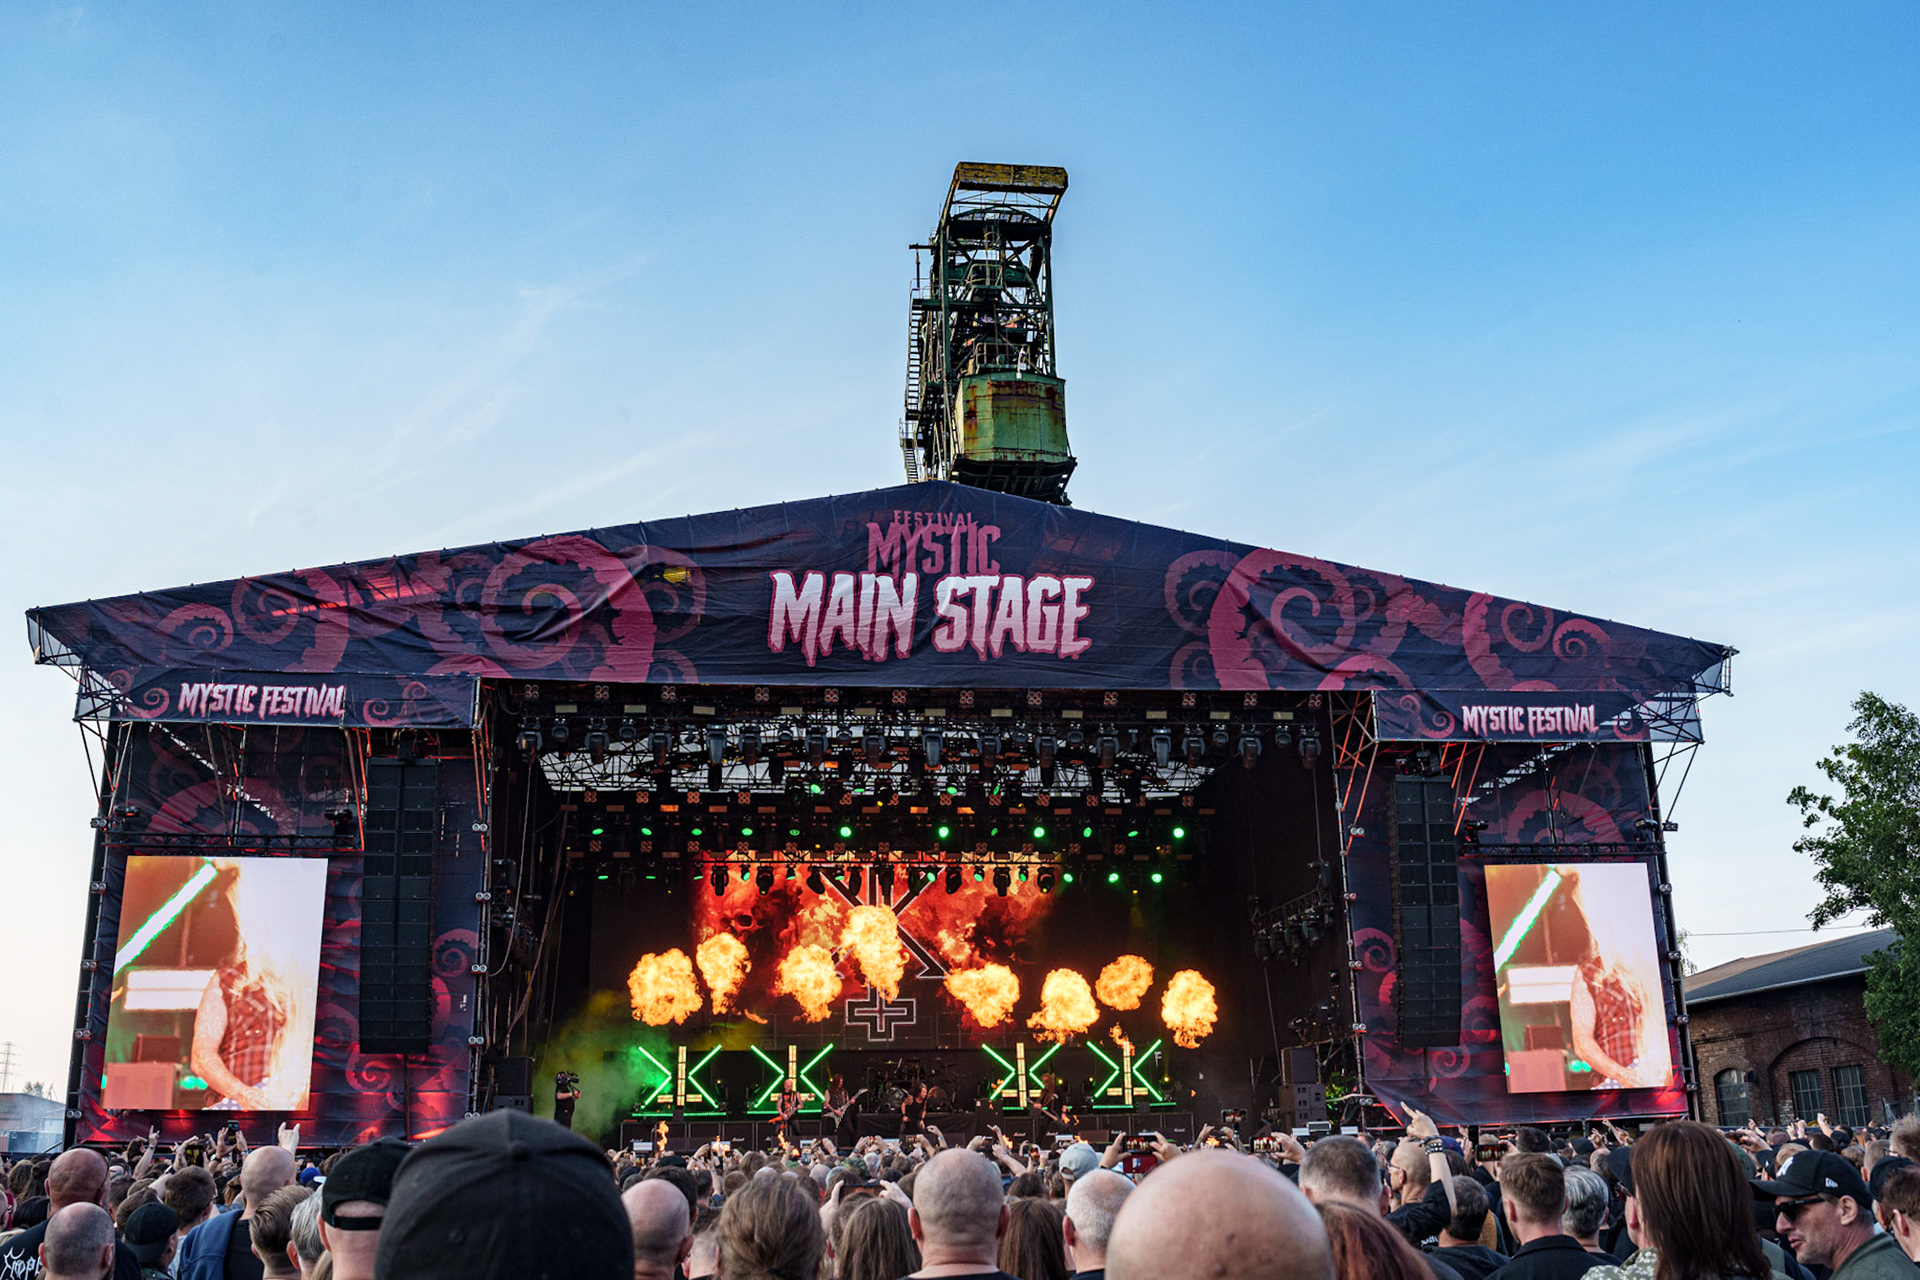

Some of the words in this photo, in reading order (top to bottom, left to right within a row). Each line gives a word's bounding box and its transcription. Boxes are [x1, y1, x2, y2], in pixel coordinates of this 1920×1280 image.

[893, 510, 979, 534] FESTIVAL
[866, 522, 1001, 579] MYSTIC
[767, 570, 919, 667] MAIN
[932, 573, 1095, 661] STAGE
[178, 683, 258, 717] MYSTIC
[258, 683, 346, 720] FESTIVAL
[1461, 705, 1524, 736] MYSTIC
[1526, 702, 1600, 738] FESTIVAL
